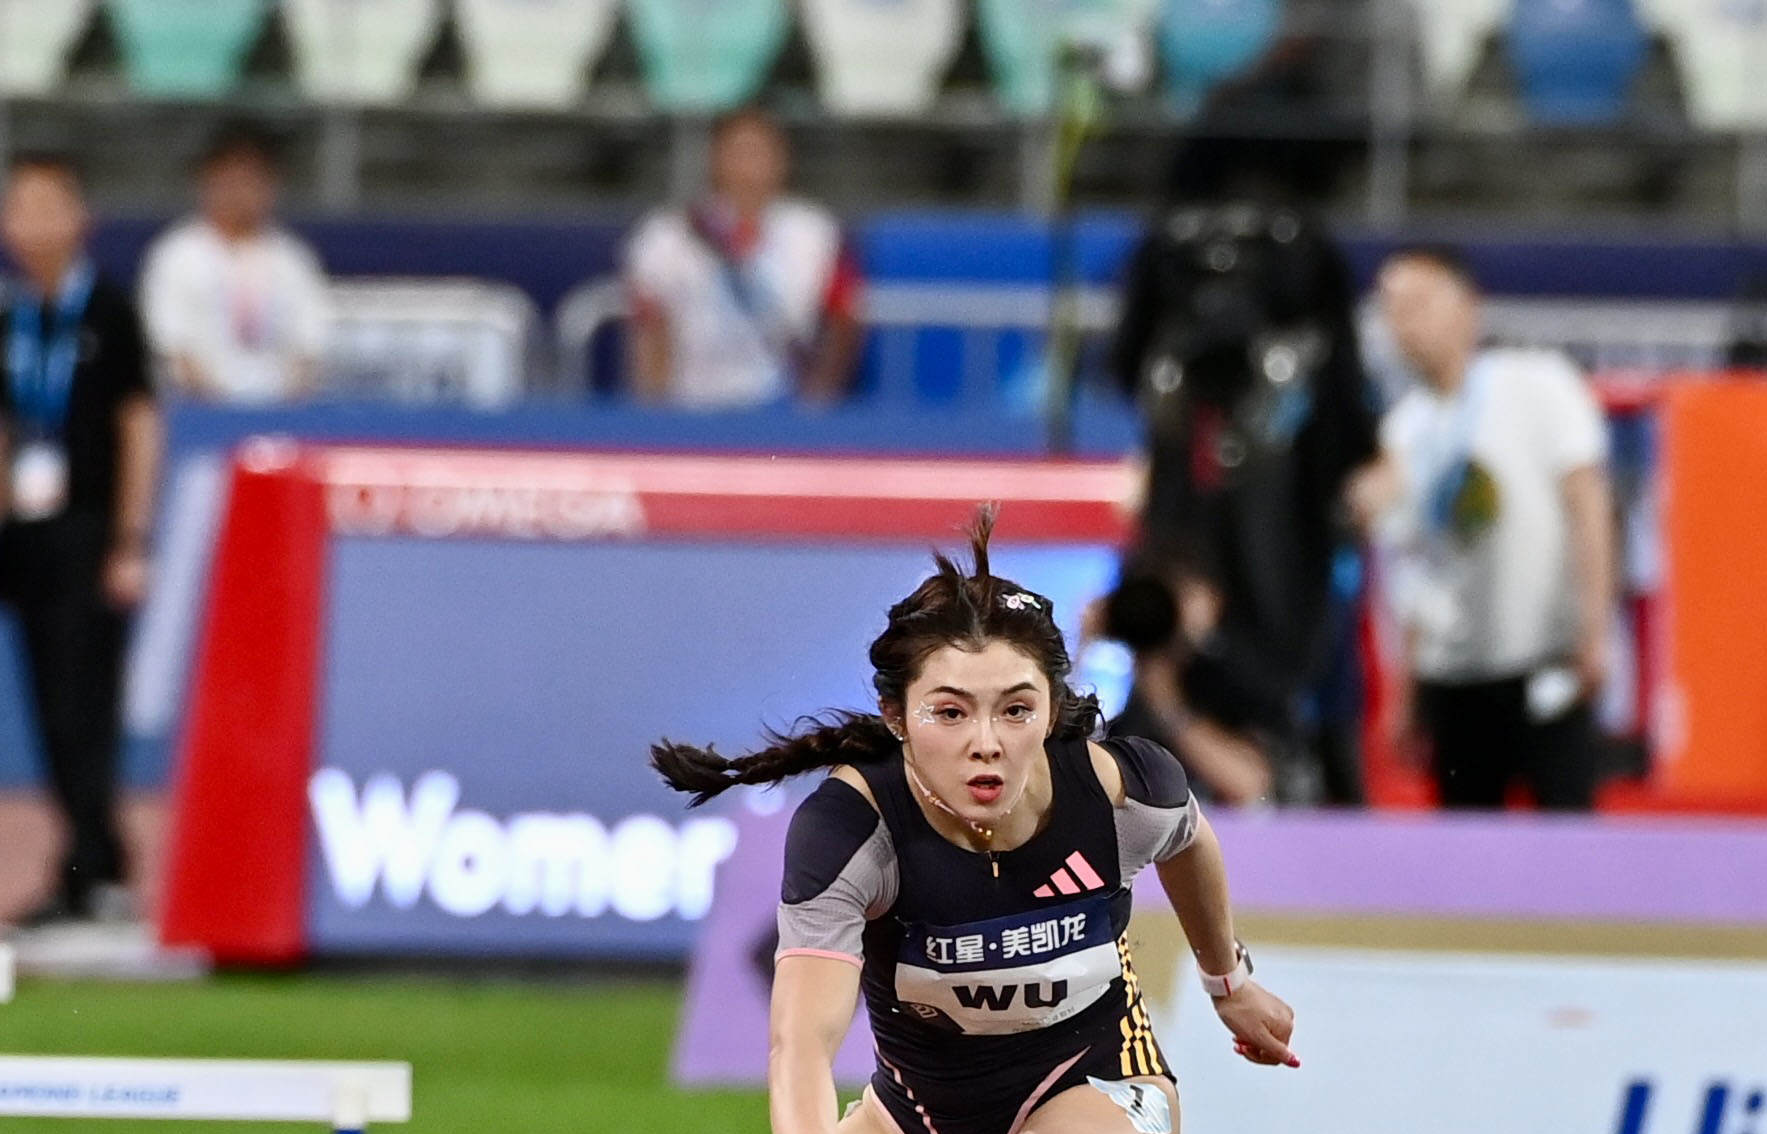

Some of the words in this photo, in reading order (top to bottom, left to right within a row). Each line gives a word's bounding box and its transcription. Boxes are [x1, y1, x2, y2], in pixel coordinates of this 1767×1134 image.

[926, 912, 1087, 965] 红星·美凯龙
[952, 978, 1069, 1012] WU
